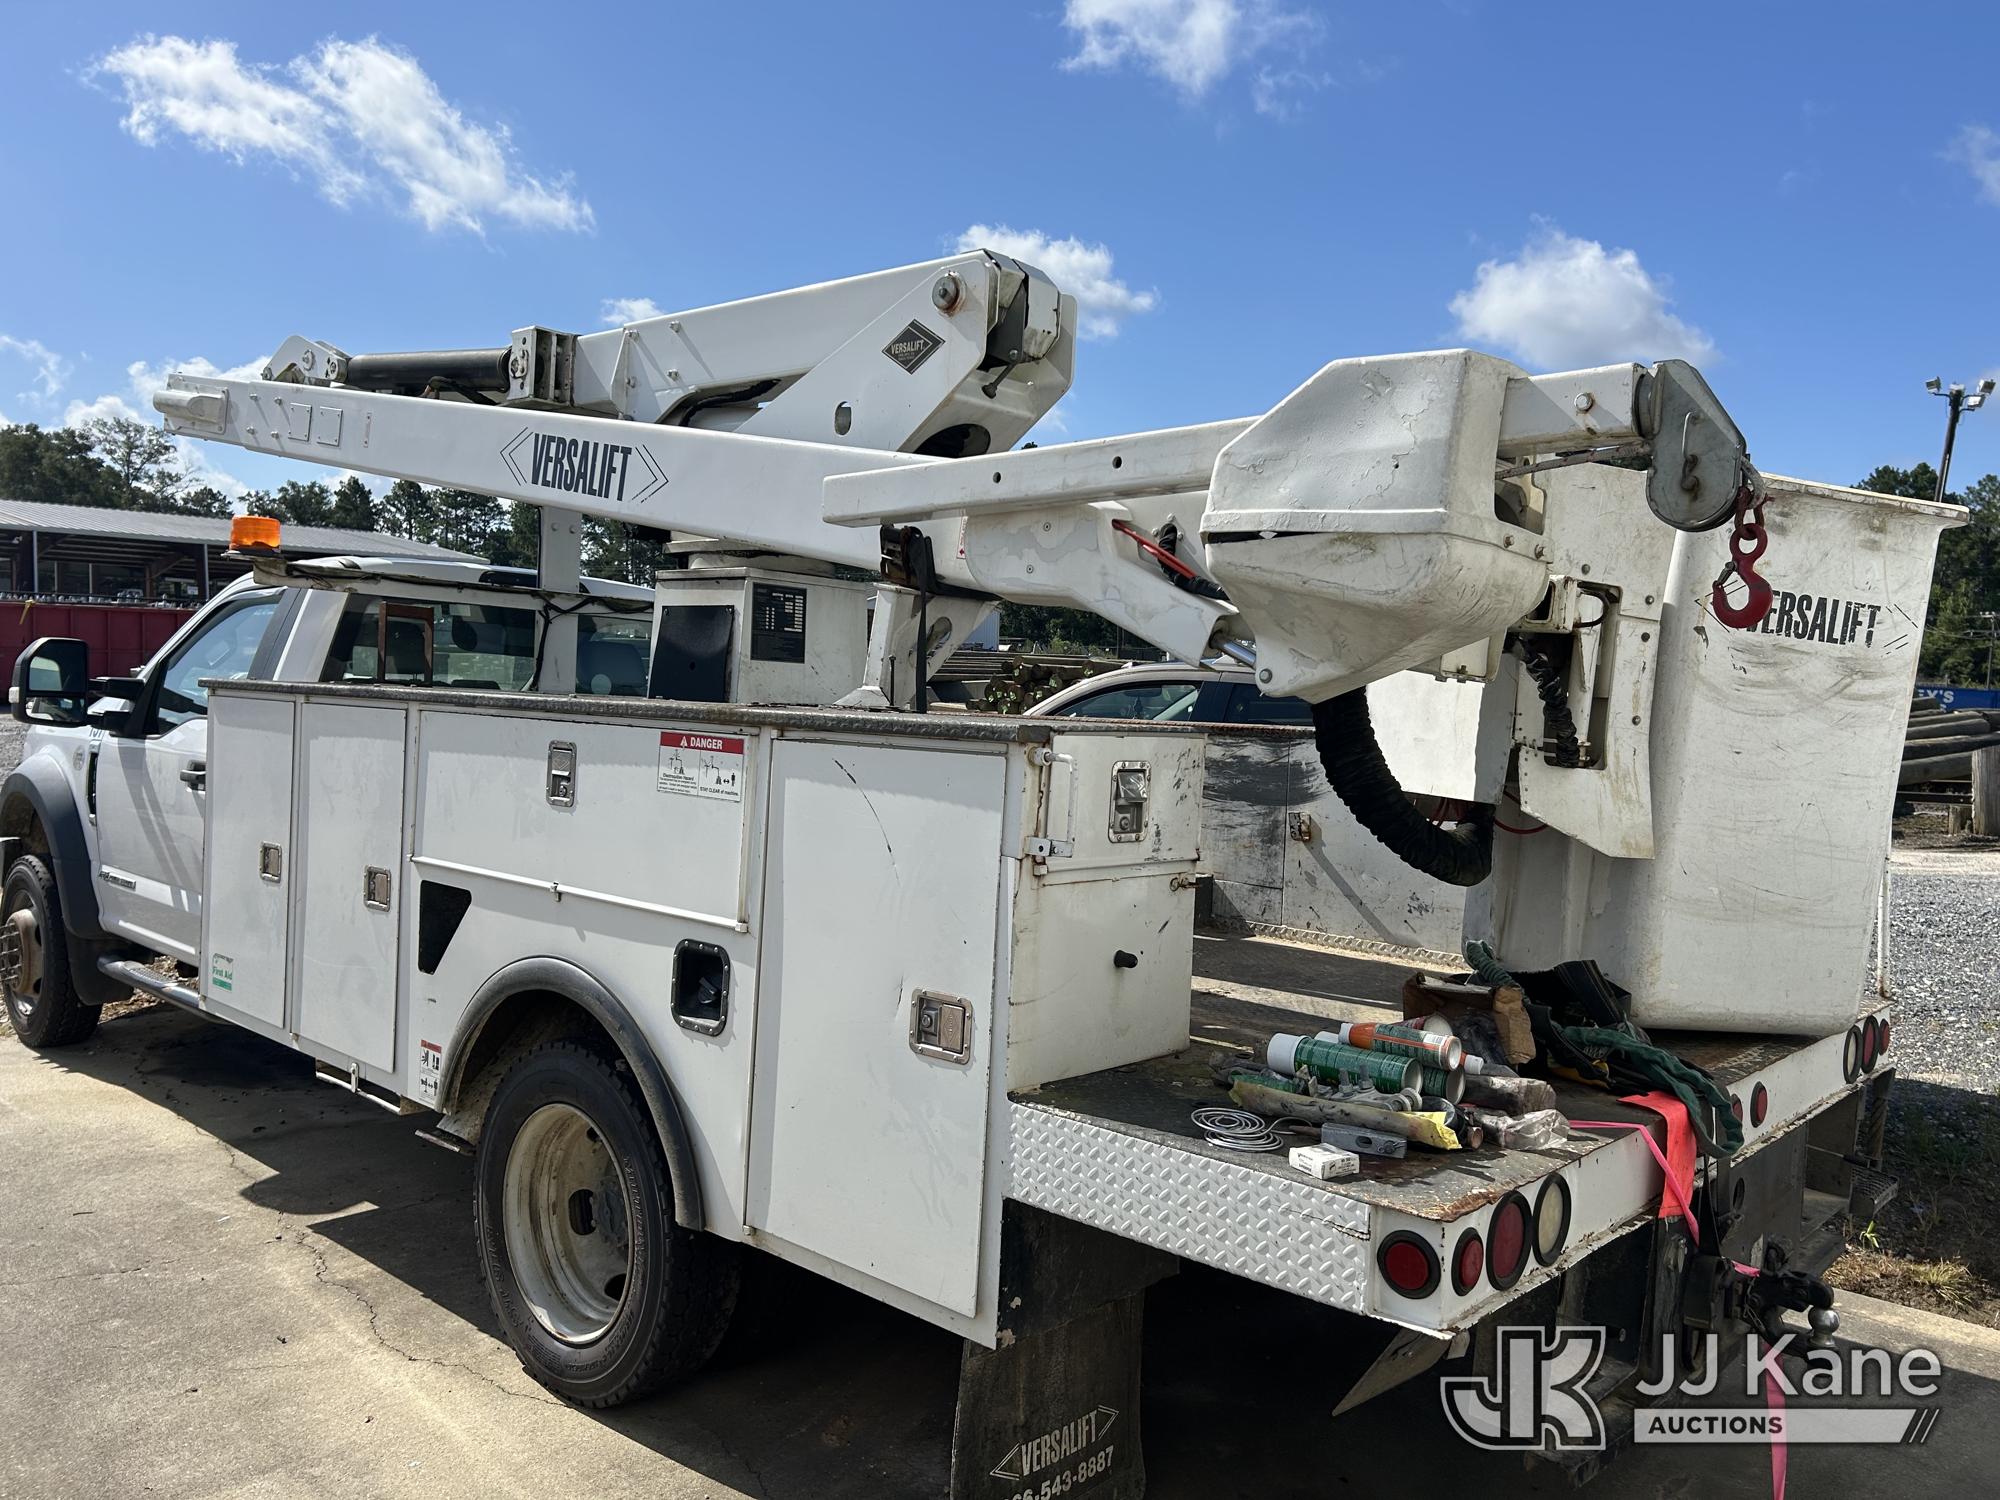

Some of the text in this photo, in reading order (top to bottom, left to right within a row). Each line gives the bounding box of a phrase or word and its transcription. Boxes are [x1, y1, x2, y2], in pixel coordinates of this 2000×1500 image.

[891, 339, 924, 355] VERSALIFT
[531, 433, 632, 501] VERSALIFT
[1746, 590, 1881, 648] ERSALIFT
[690, 737, 722, 750] DANGER
[1021, 1410, 1097, 1476] VERSALIFT
